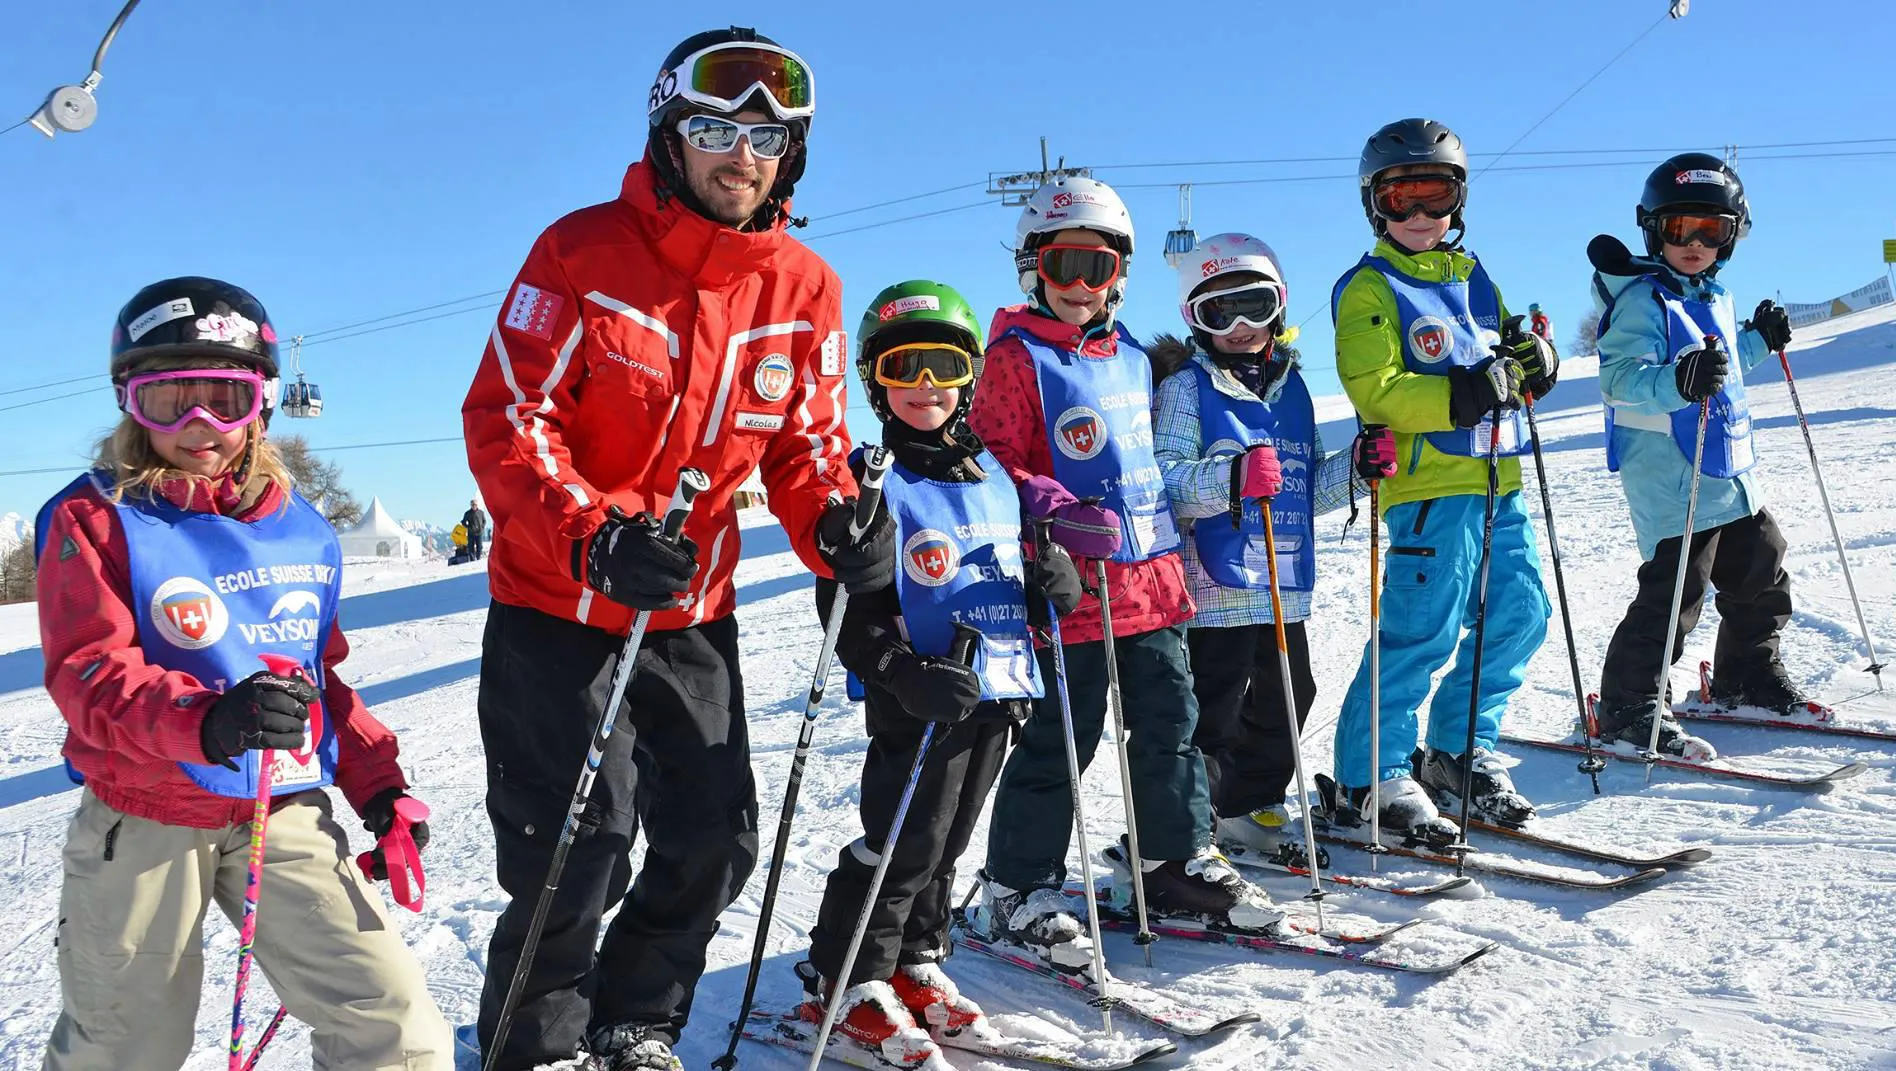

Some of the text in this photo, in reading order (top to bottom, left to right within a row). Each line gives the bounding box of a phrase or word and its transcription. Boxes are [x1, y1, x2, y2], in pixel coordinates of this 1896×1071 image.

[744, 419, 777, 428] Nicolas
[214, 572, 271, 594] ECOLE
[269, 565, 313, 584] SUISSE
[968, 605, 987, 621] +41
[248, 801, 266, 866] ATOMIC
